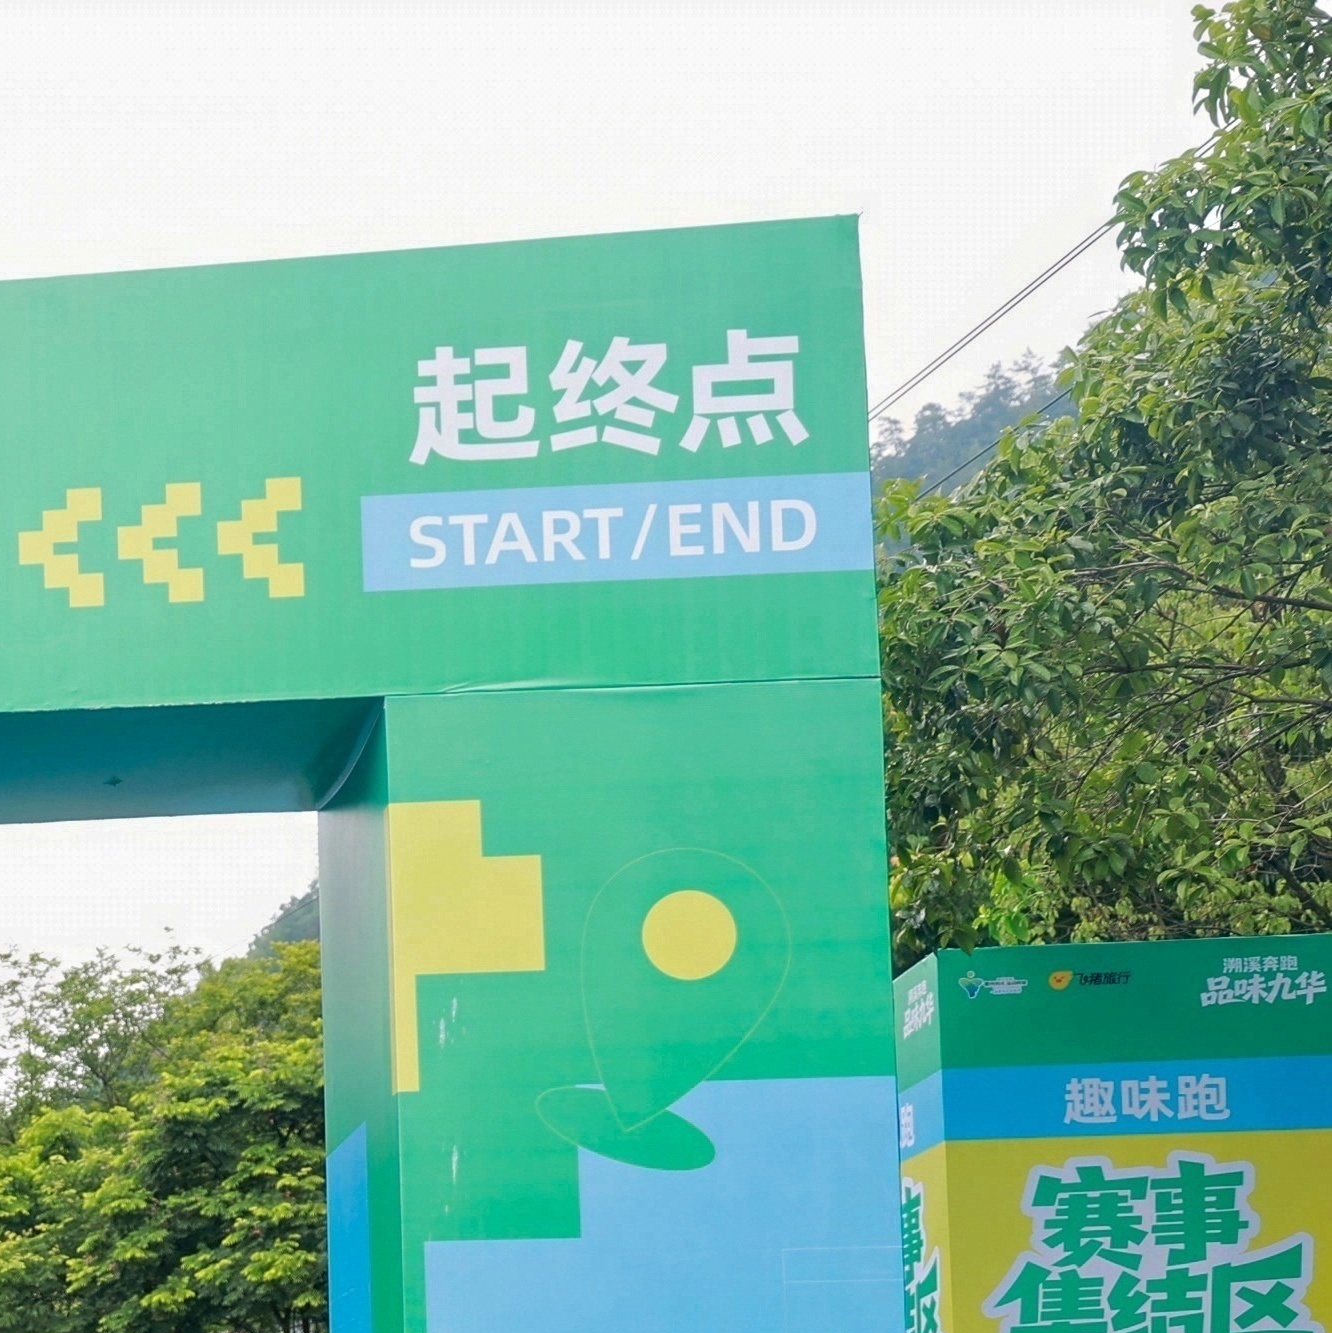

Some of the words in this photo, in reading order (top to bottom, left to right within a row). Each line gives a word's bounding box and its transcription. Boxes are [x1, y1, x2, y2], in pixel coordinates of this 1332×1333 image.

[409, 329, 809, 465] 起终点
[1200, 970, 1327, 1007] 品味九华
[1223, 955, 1298, 973] 溯溪奔跑
[1062, 1073, 1231, 1125] 趣味跑
[1029, 1158, 1251, 1271] 赛事
